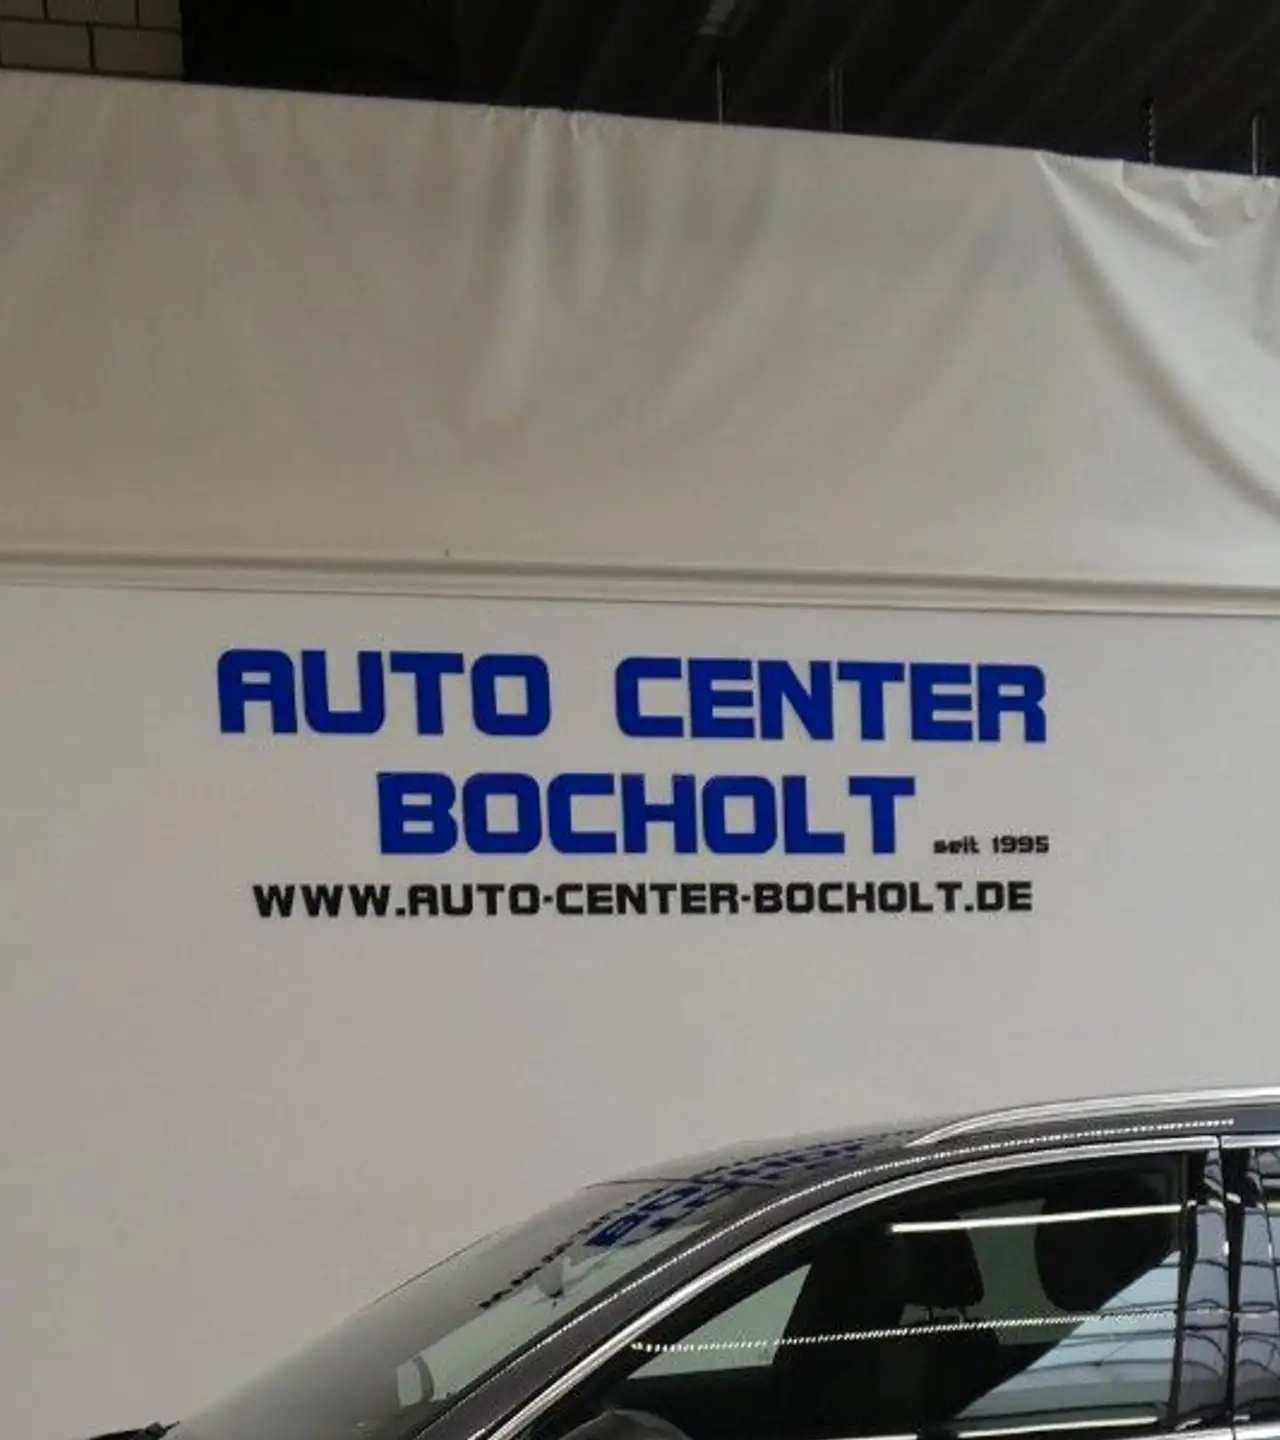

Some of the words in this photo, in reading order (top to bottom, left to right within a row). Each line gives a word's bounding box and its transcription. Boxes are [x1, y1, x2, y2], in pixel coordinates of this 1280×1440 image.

[216, 648, 552, 738] AUTO
[614, 656, 1048, 744] CENTER
[375, 771, 916, 856] BOCHOLT
[933, 835, 981, 855] seit
[991, 834, 1050, 855] 1995
[251, 880, 1033, 919] WWW.AUTO-CENTER-BOCHOLT.DE
